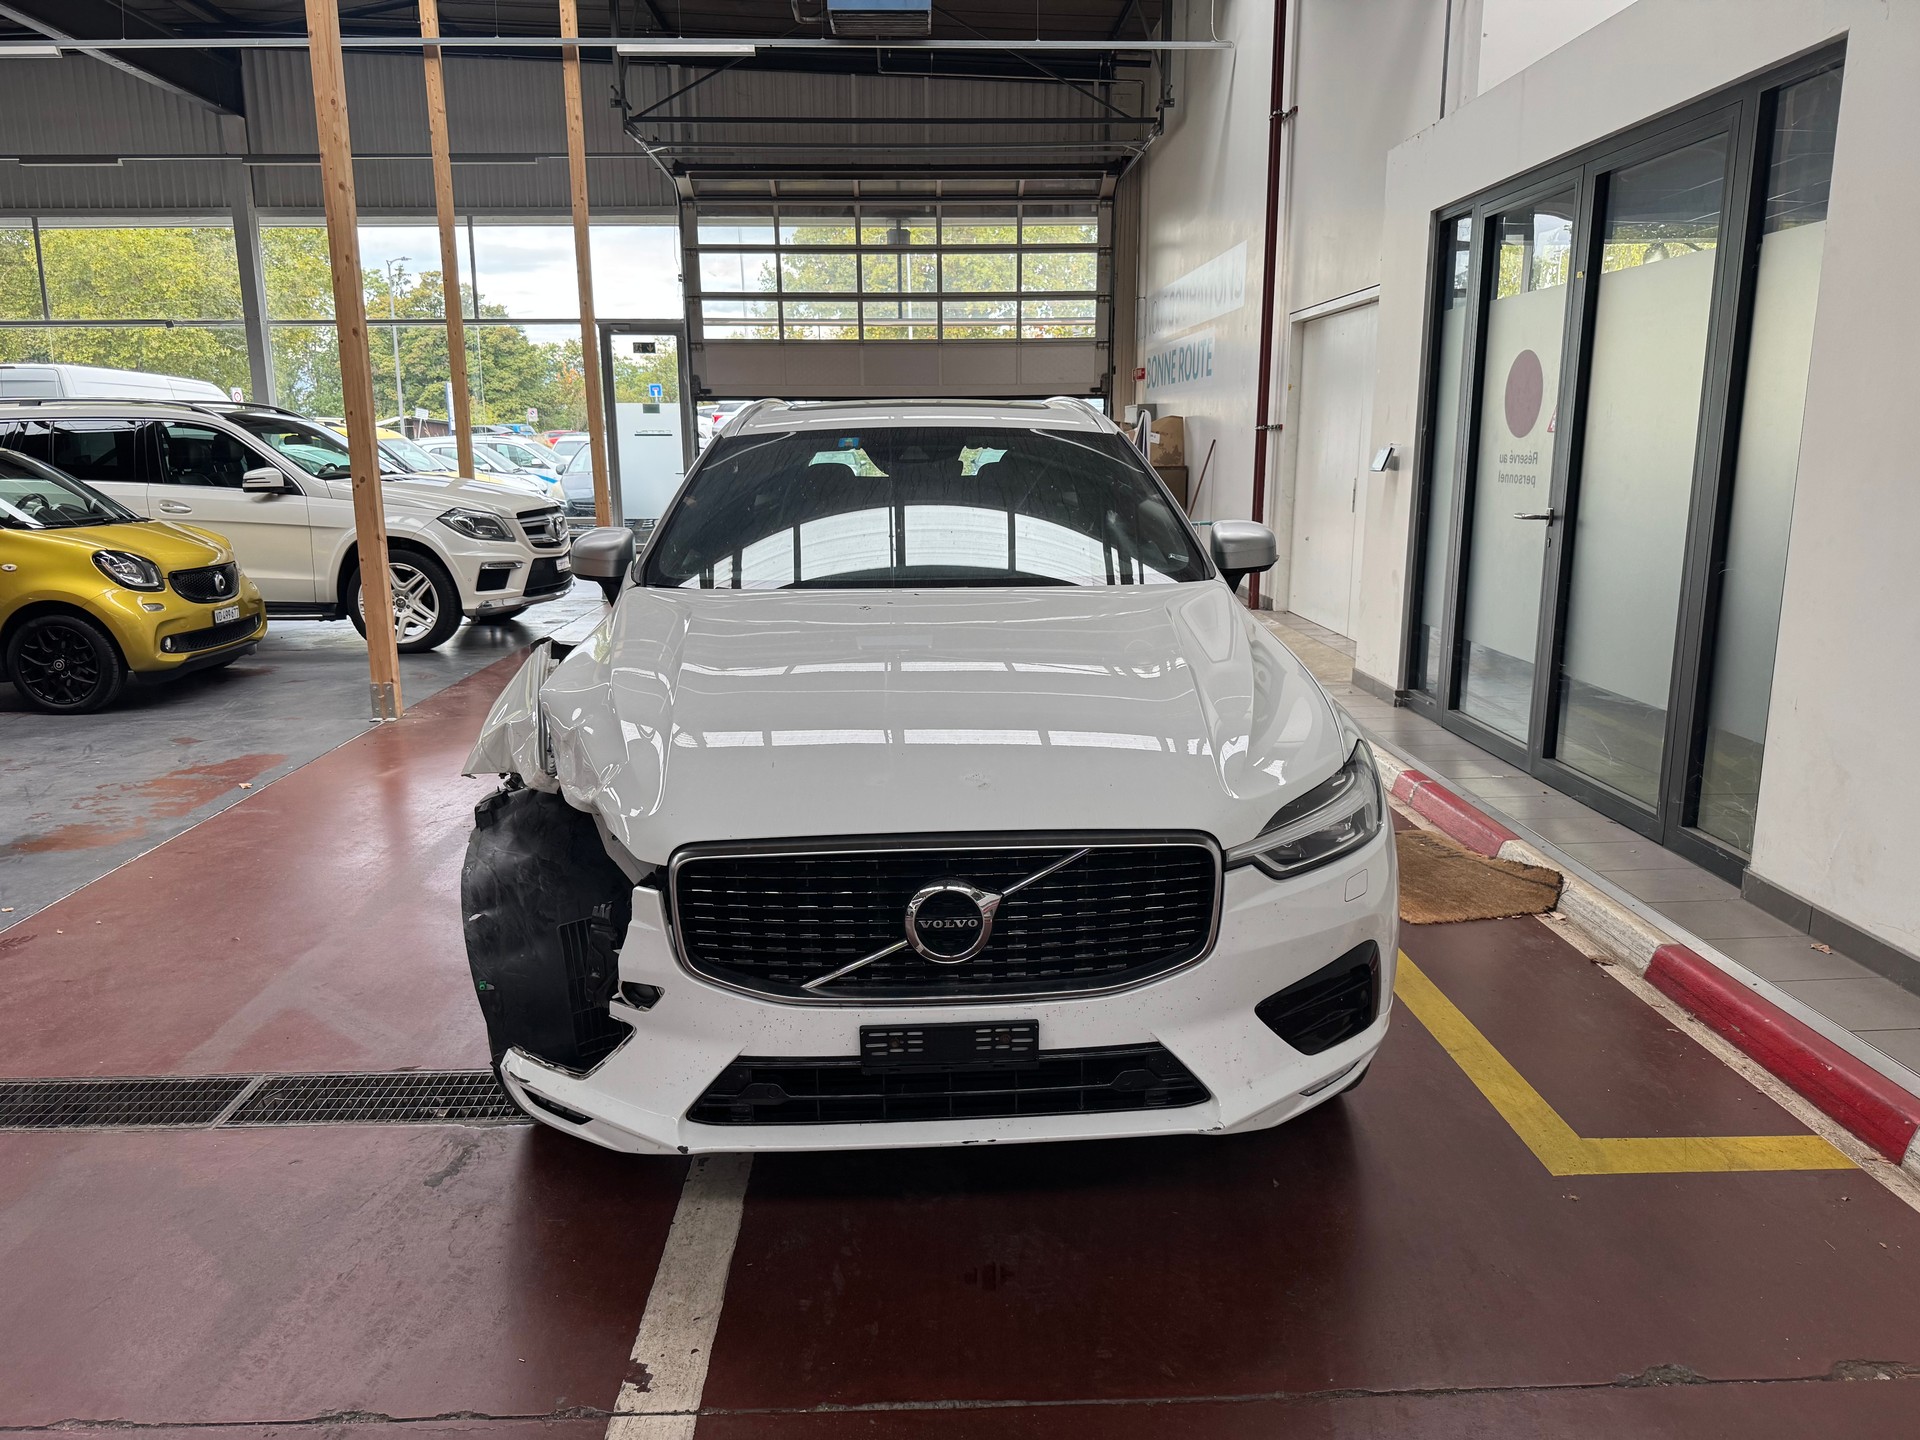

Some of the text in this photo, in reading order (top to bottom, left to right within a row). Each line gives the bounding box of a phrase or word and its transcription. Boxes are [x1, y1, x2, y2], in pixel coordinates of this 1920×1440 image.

[1146, 337, 1213, 389] BONNE ROUTE
[918, 918, 979, 929] VOLVO
